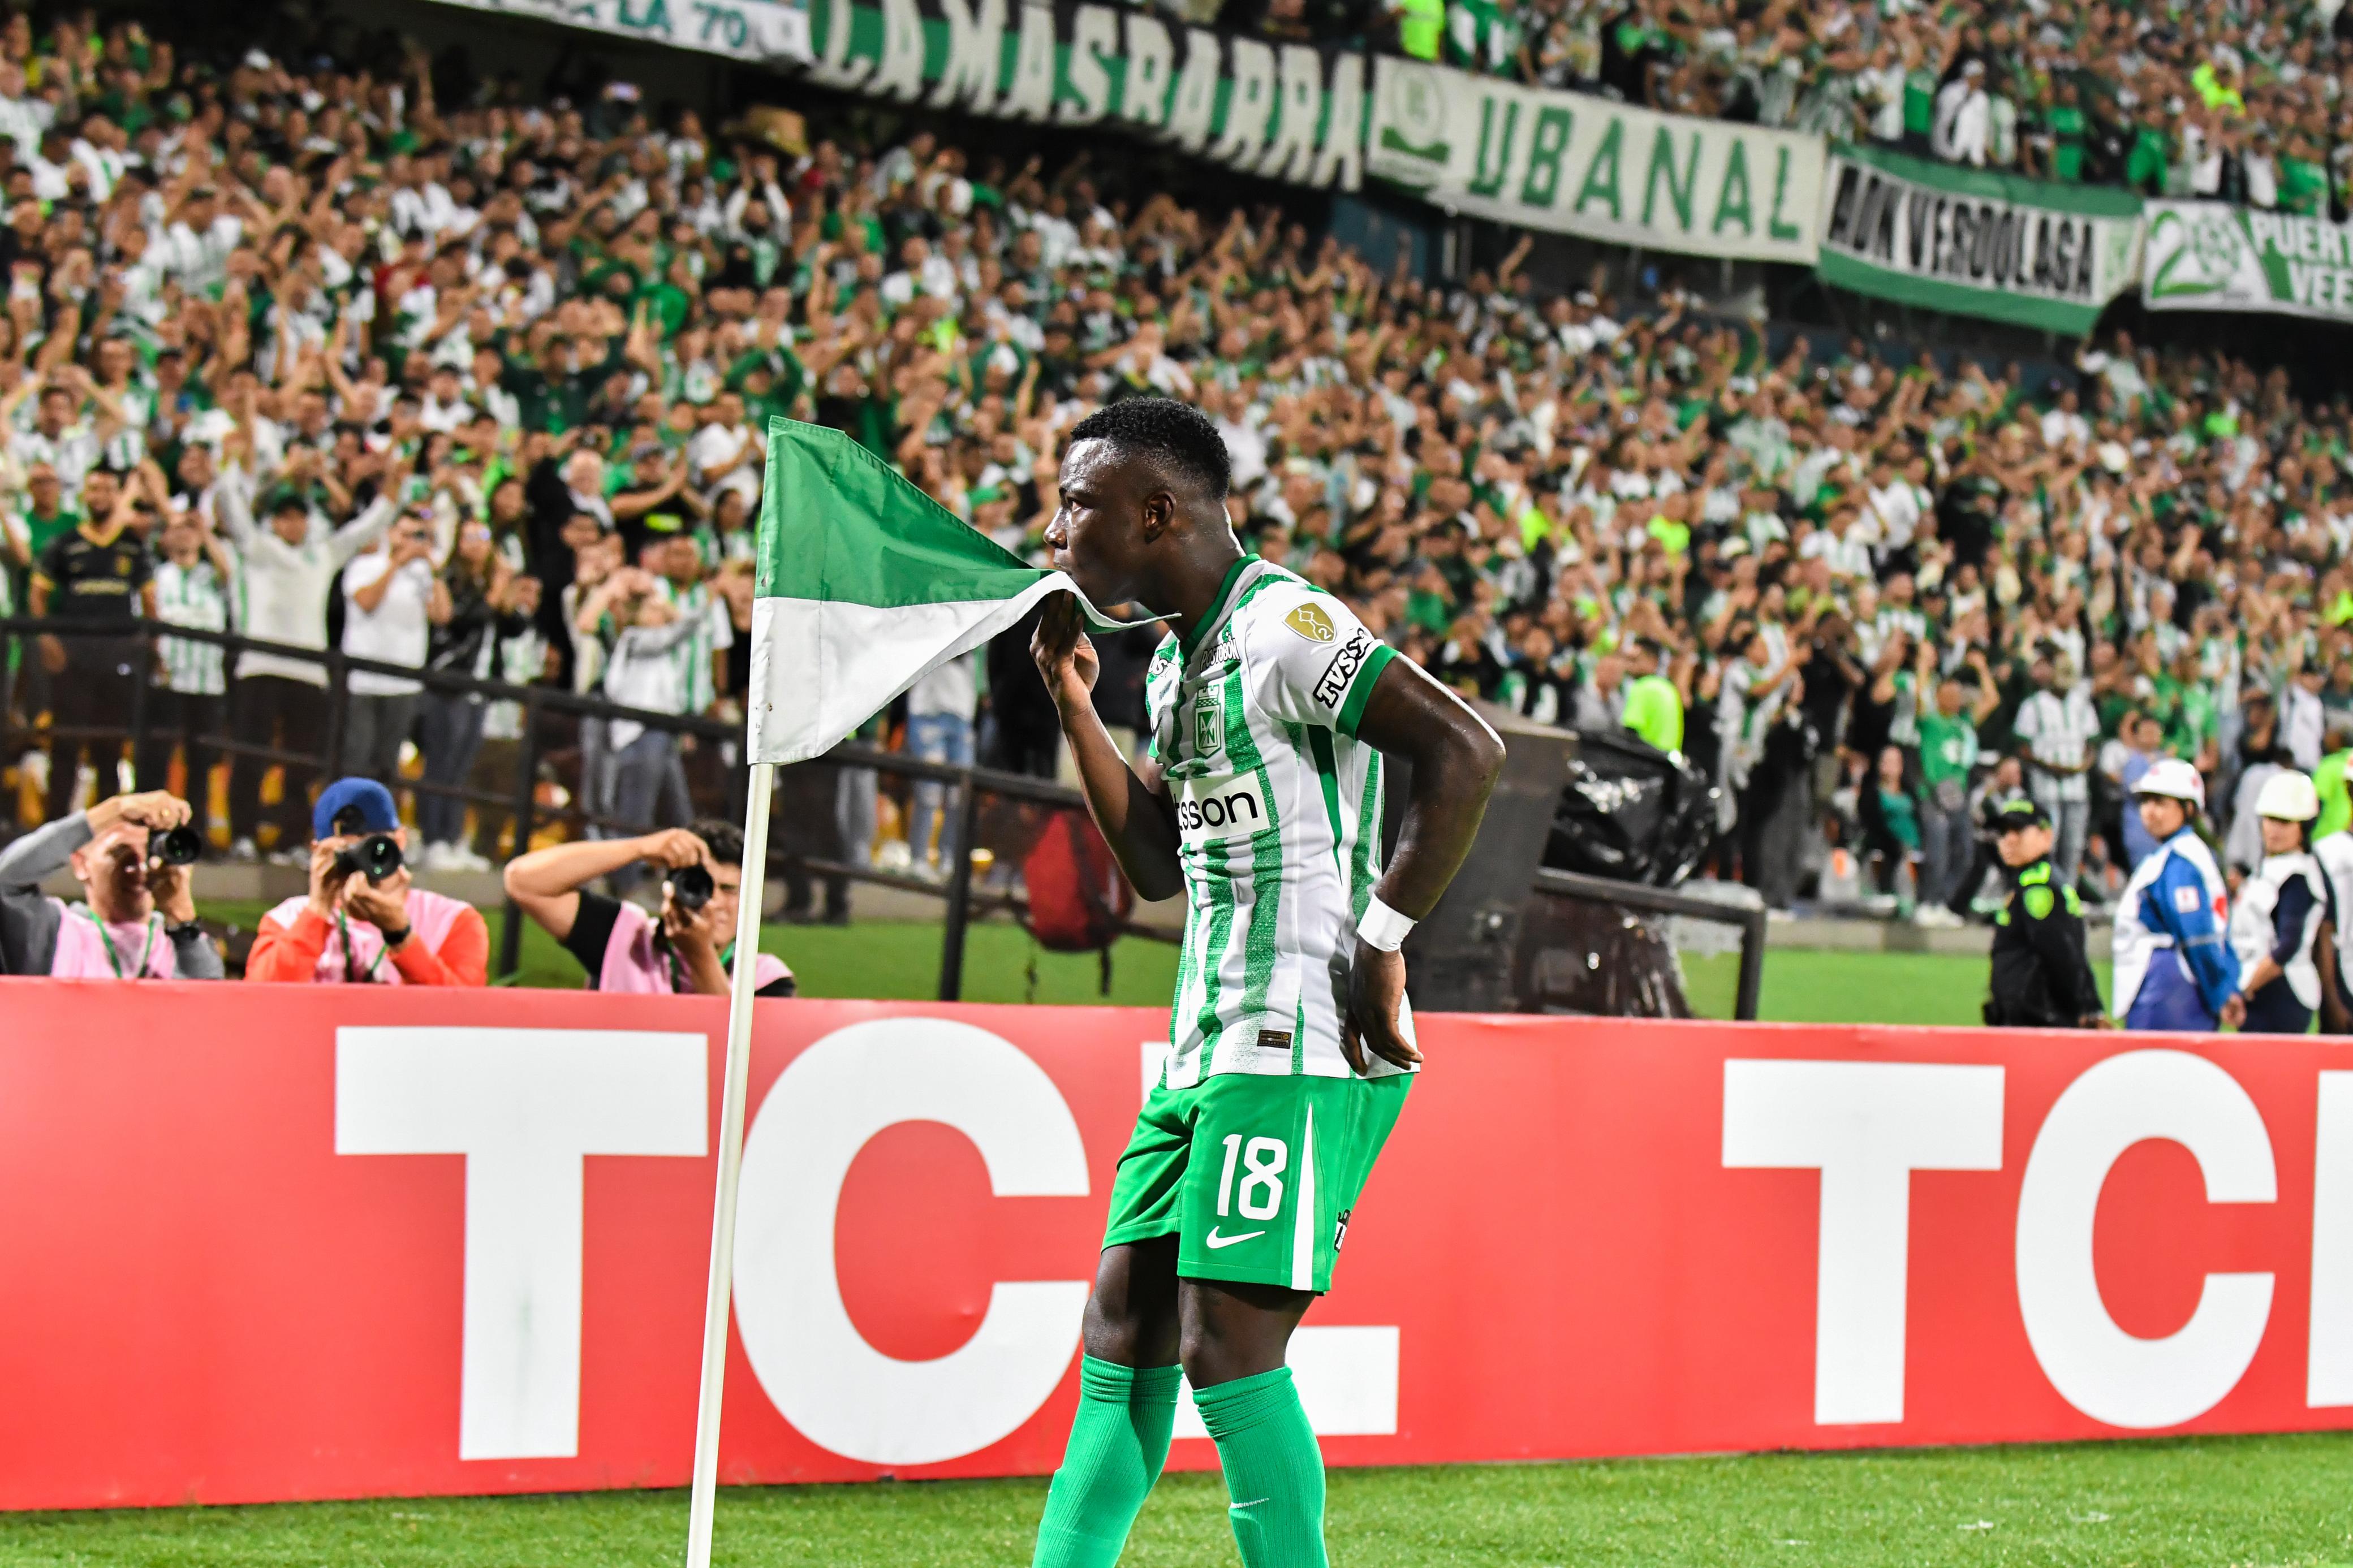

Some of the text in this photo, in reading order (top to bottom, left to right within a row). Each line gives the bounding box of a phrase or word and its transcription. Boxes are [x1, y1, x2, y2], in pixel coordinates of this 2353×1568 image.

[692, 1, 748, 49] 70
[1318, 628, 1332, 640] 2
[1217, 1134, 1288, 1221] 18
